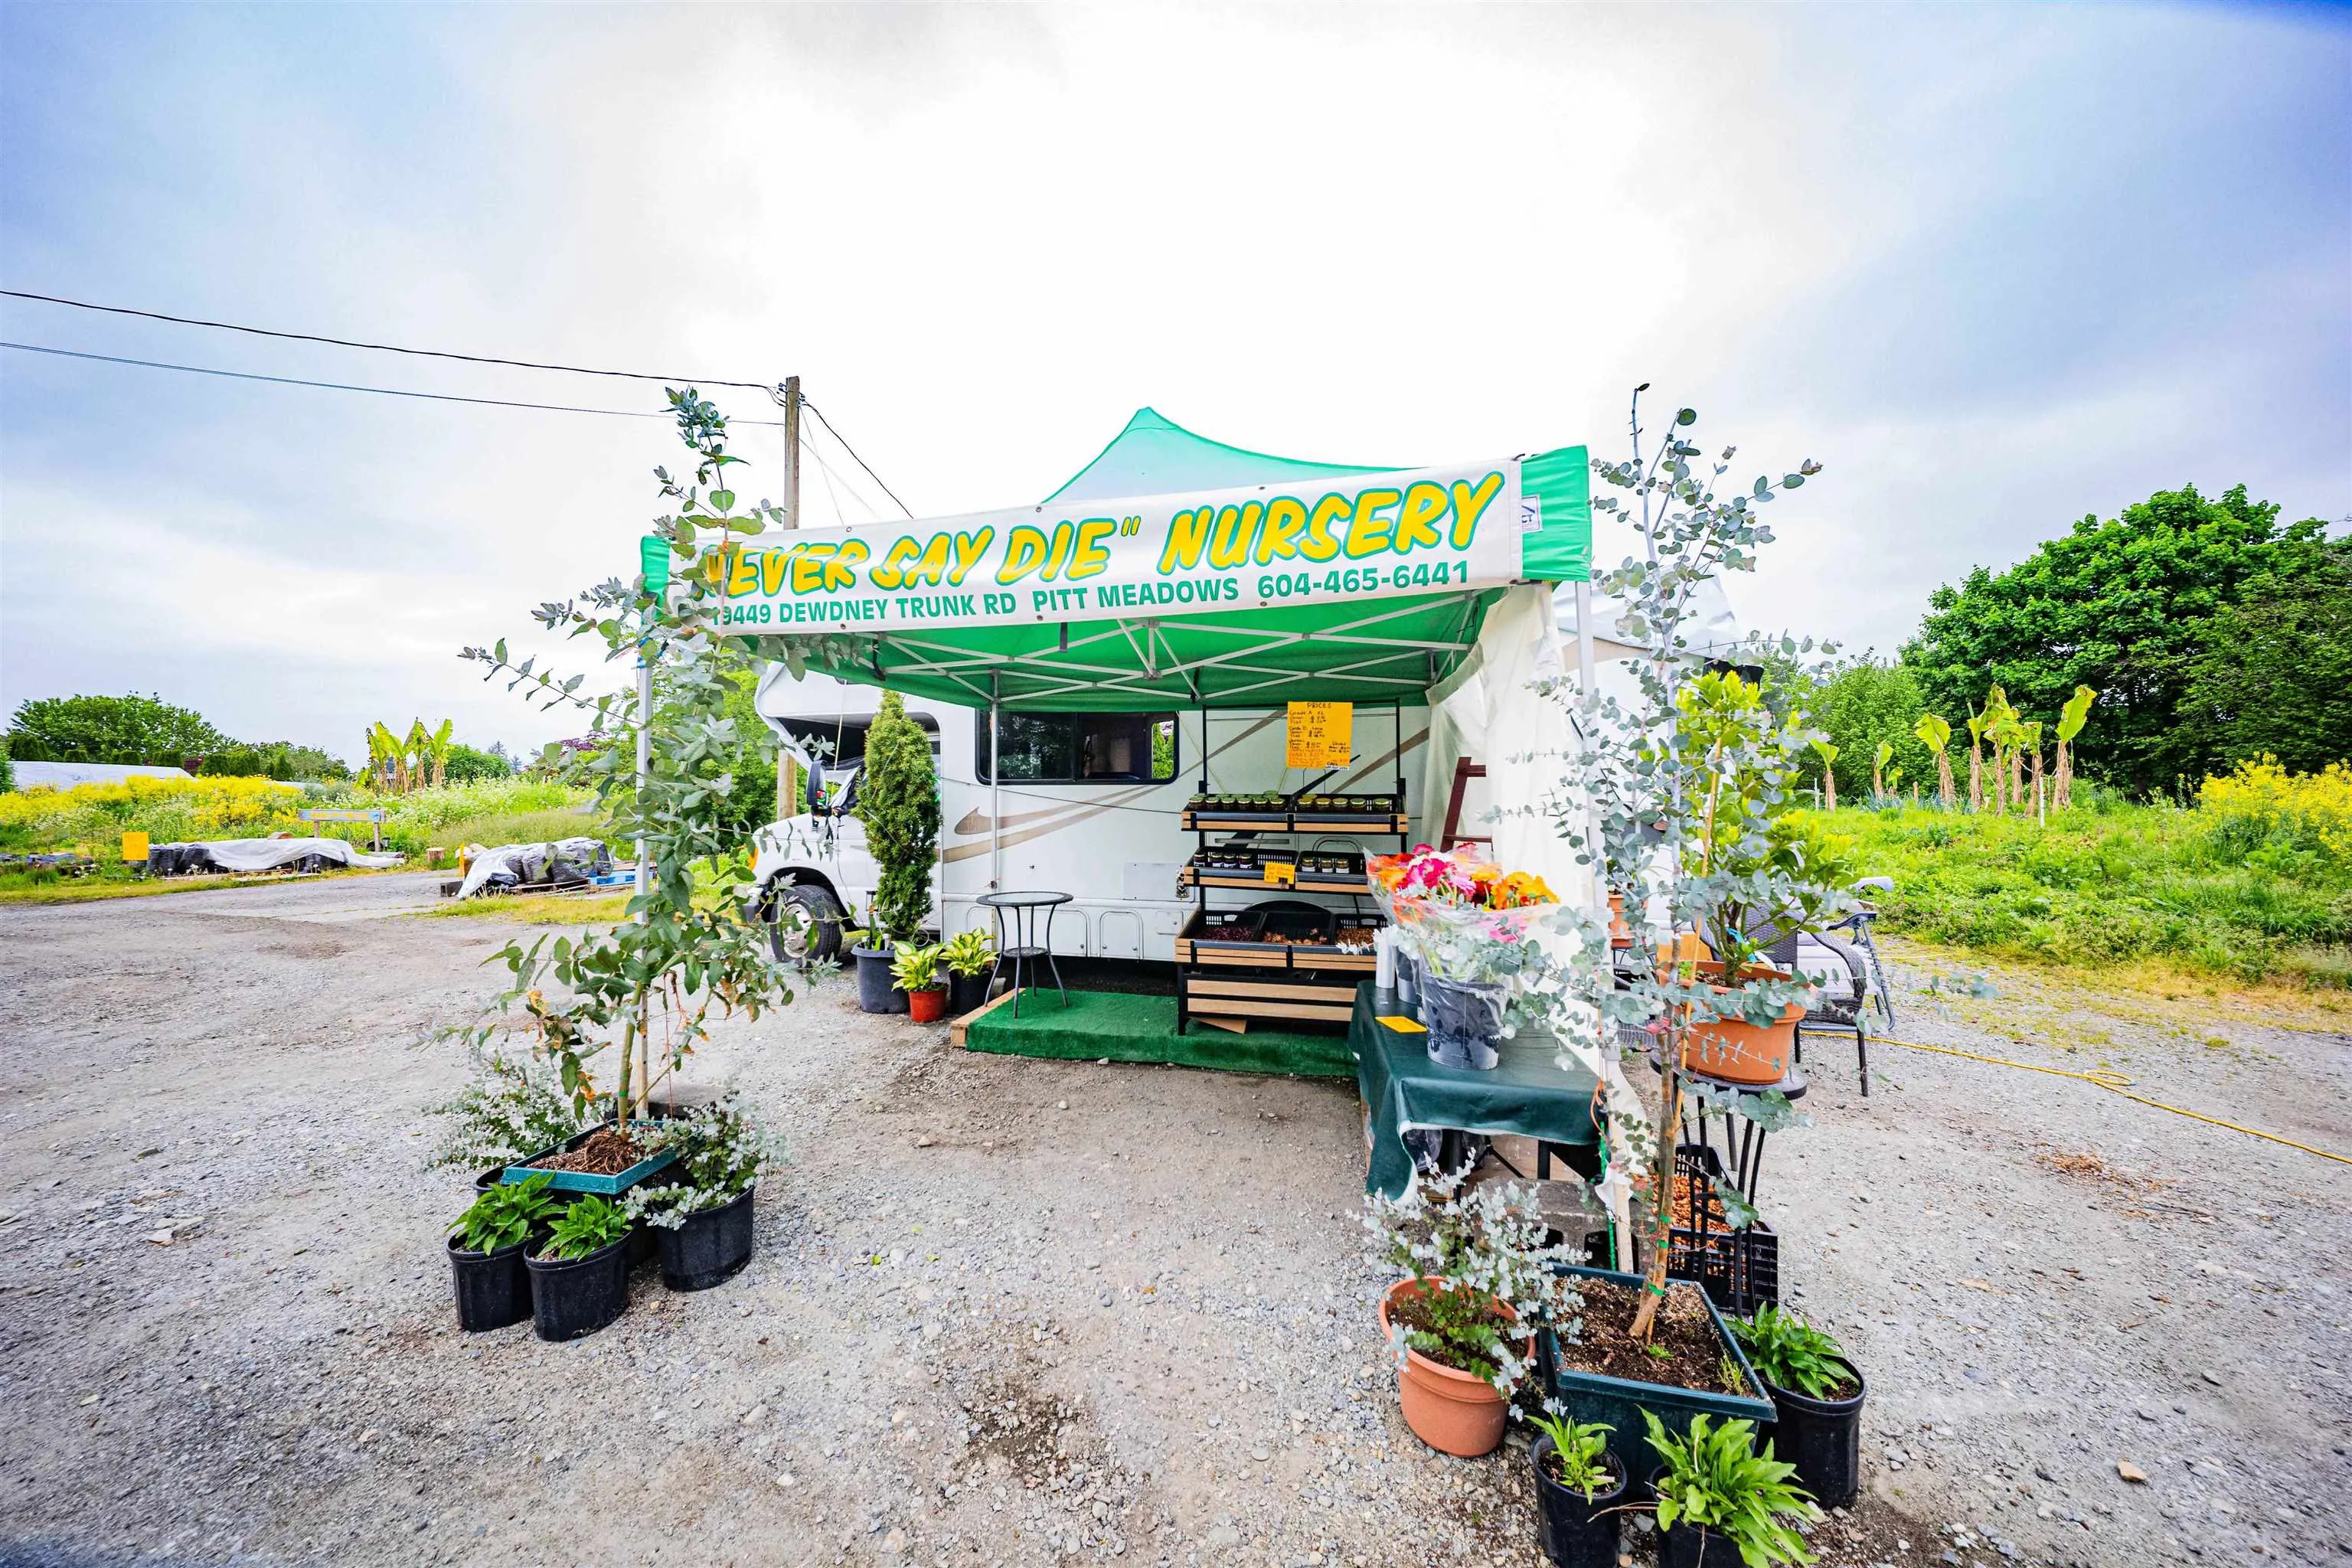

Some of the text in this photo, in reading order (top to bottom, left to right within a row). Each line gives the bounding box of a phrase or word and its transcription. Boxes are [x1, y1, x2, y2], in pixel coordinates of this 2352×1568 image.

[869, 524, 995, 591] SAY
[1156, 471, 1504, 576] NURSERY
[779, 598, 888, 623] DEWDNEY
[896, 594, 976, 619] TRUNK
[984, 593, 1017, 615] RD
[1032, 587, 1088, 612] PITT
[1097, 577, 1239, 608] MEADOWS
[1257, 560, 1468, 598] 604-465-6441
